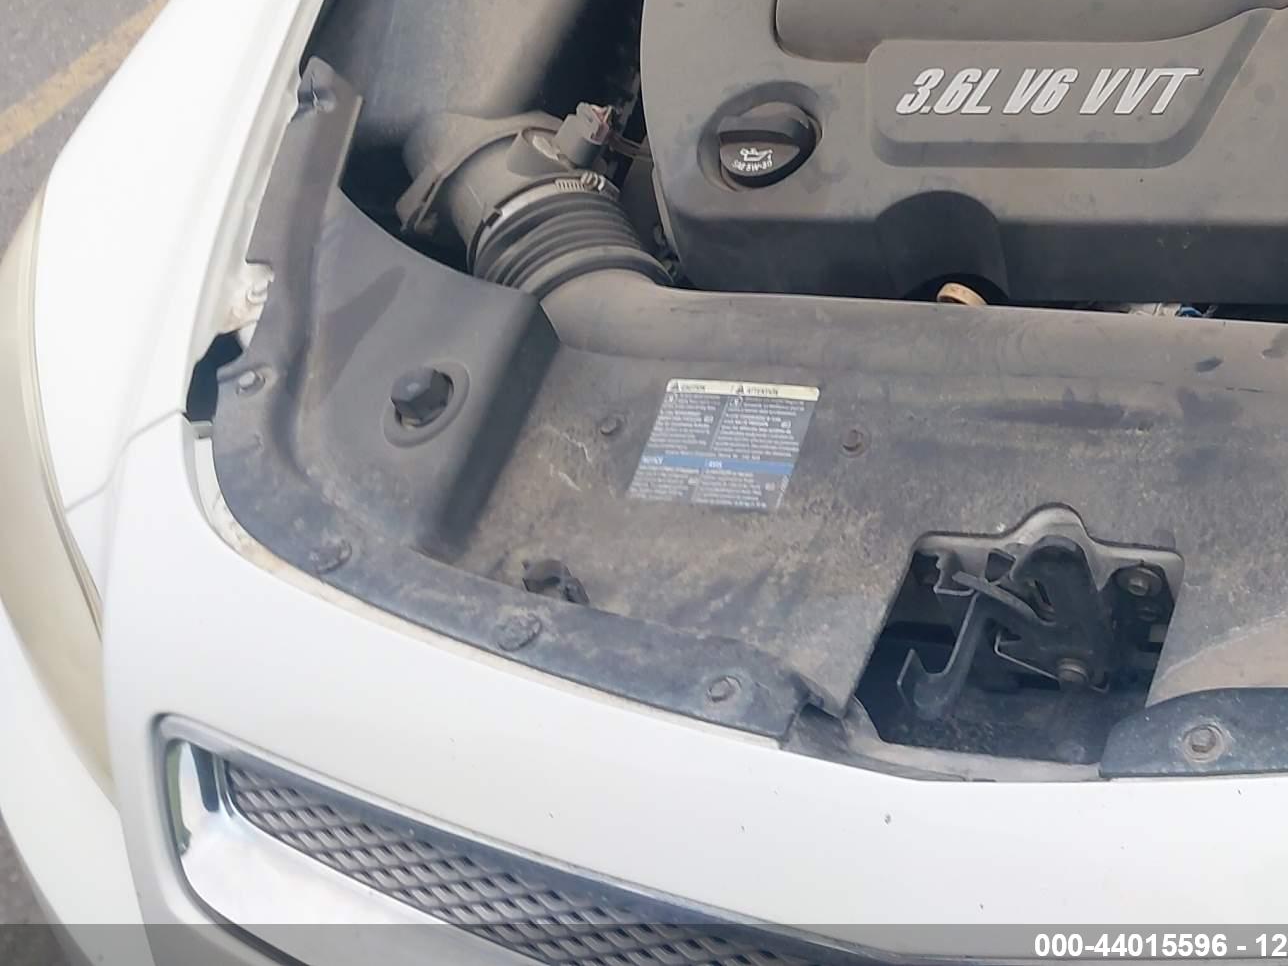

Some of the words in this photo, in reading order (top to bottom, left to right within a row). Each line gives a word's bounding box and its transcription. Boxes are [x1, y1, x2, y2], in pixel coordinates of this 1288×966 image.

[895, 67, 1002, 116] 3.6L
[1002, 67, 1079, 116] V6
[1079, 67, 1203, 116] VVT
